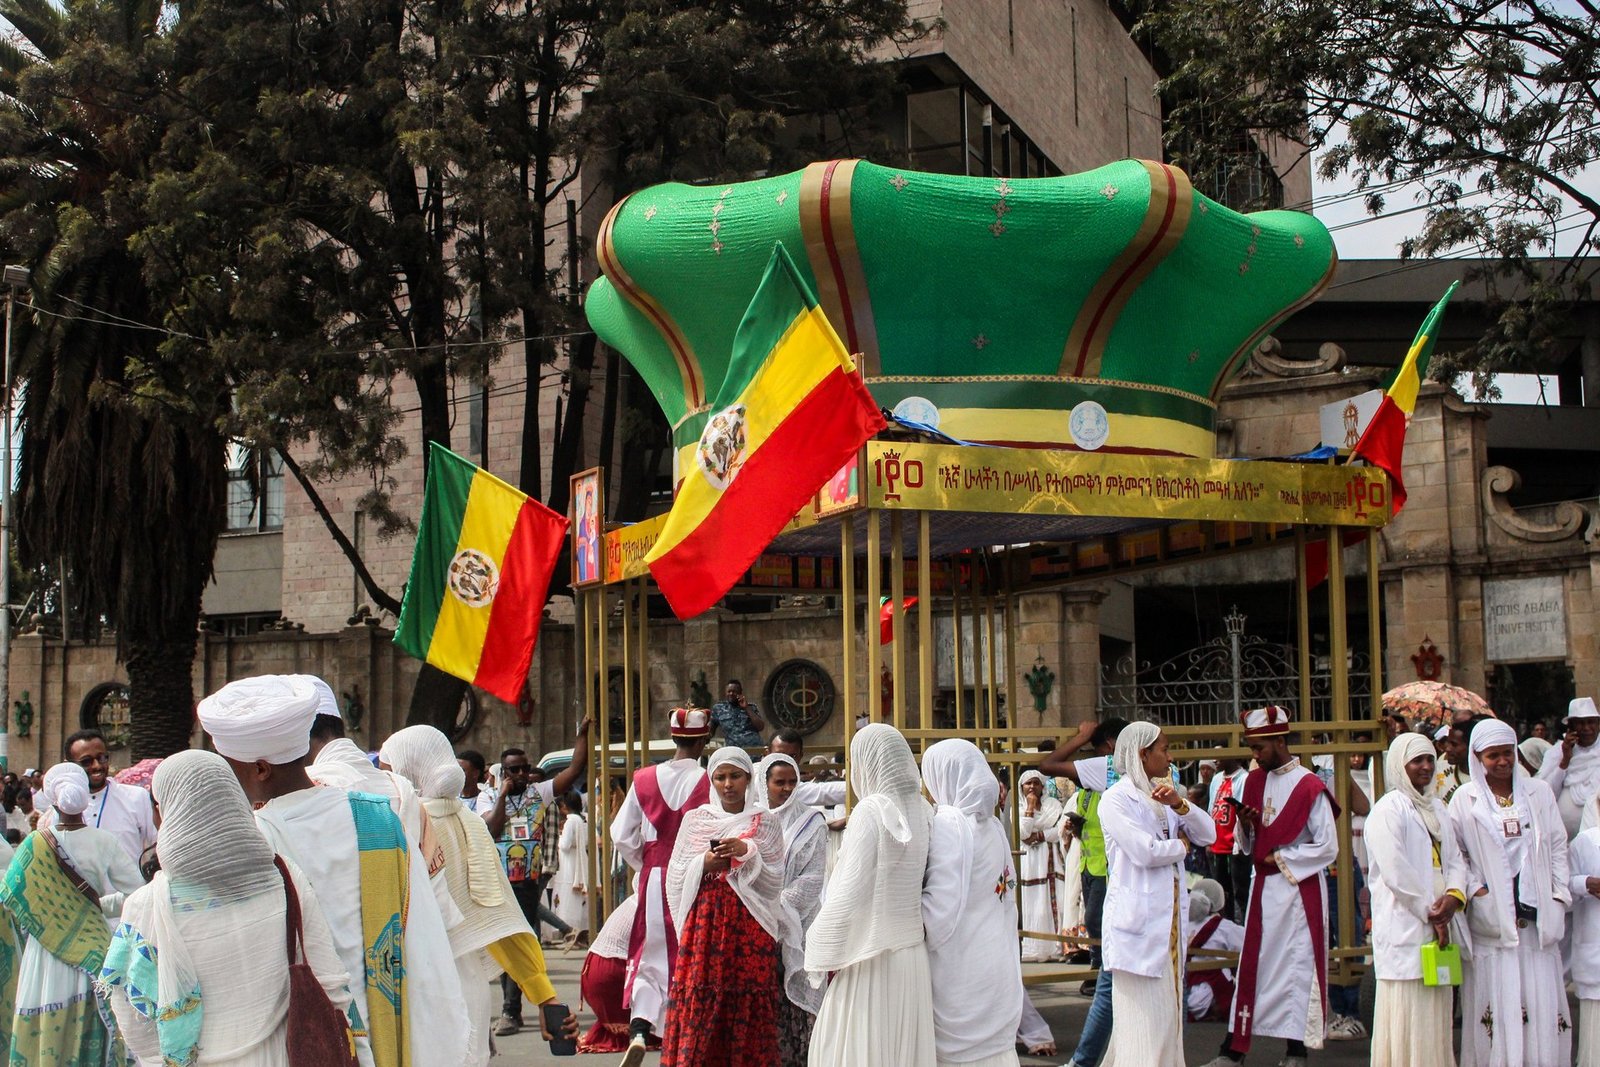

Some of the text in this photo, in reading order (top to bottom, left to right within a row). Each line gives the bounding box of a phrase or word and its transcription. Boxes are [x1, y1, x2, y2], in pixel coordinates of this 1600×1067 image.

[964, 466, 1000, 490] ሁላችን
[1003, 470, 1043, 493] በሥላሴ
[1045, 472, 1102, 495] የተጠመቅን
[1105, 475, 1153, 497] ምእመናን
[1156, 476, 1200, 500] የክርስቶስ
[1490, 601, 1560, 617] ADDIS ABABA
[1494, 620, 1558, 636] UNIVERSITY
